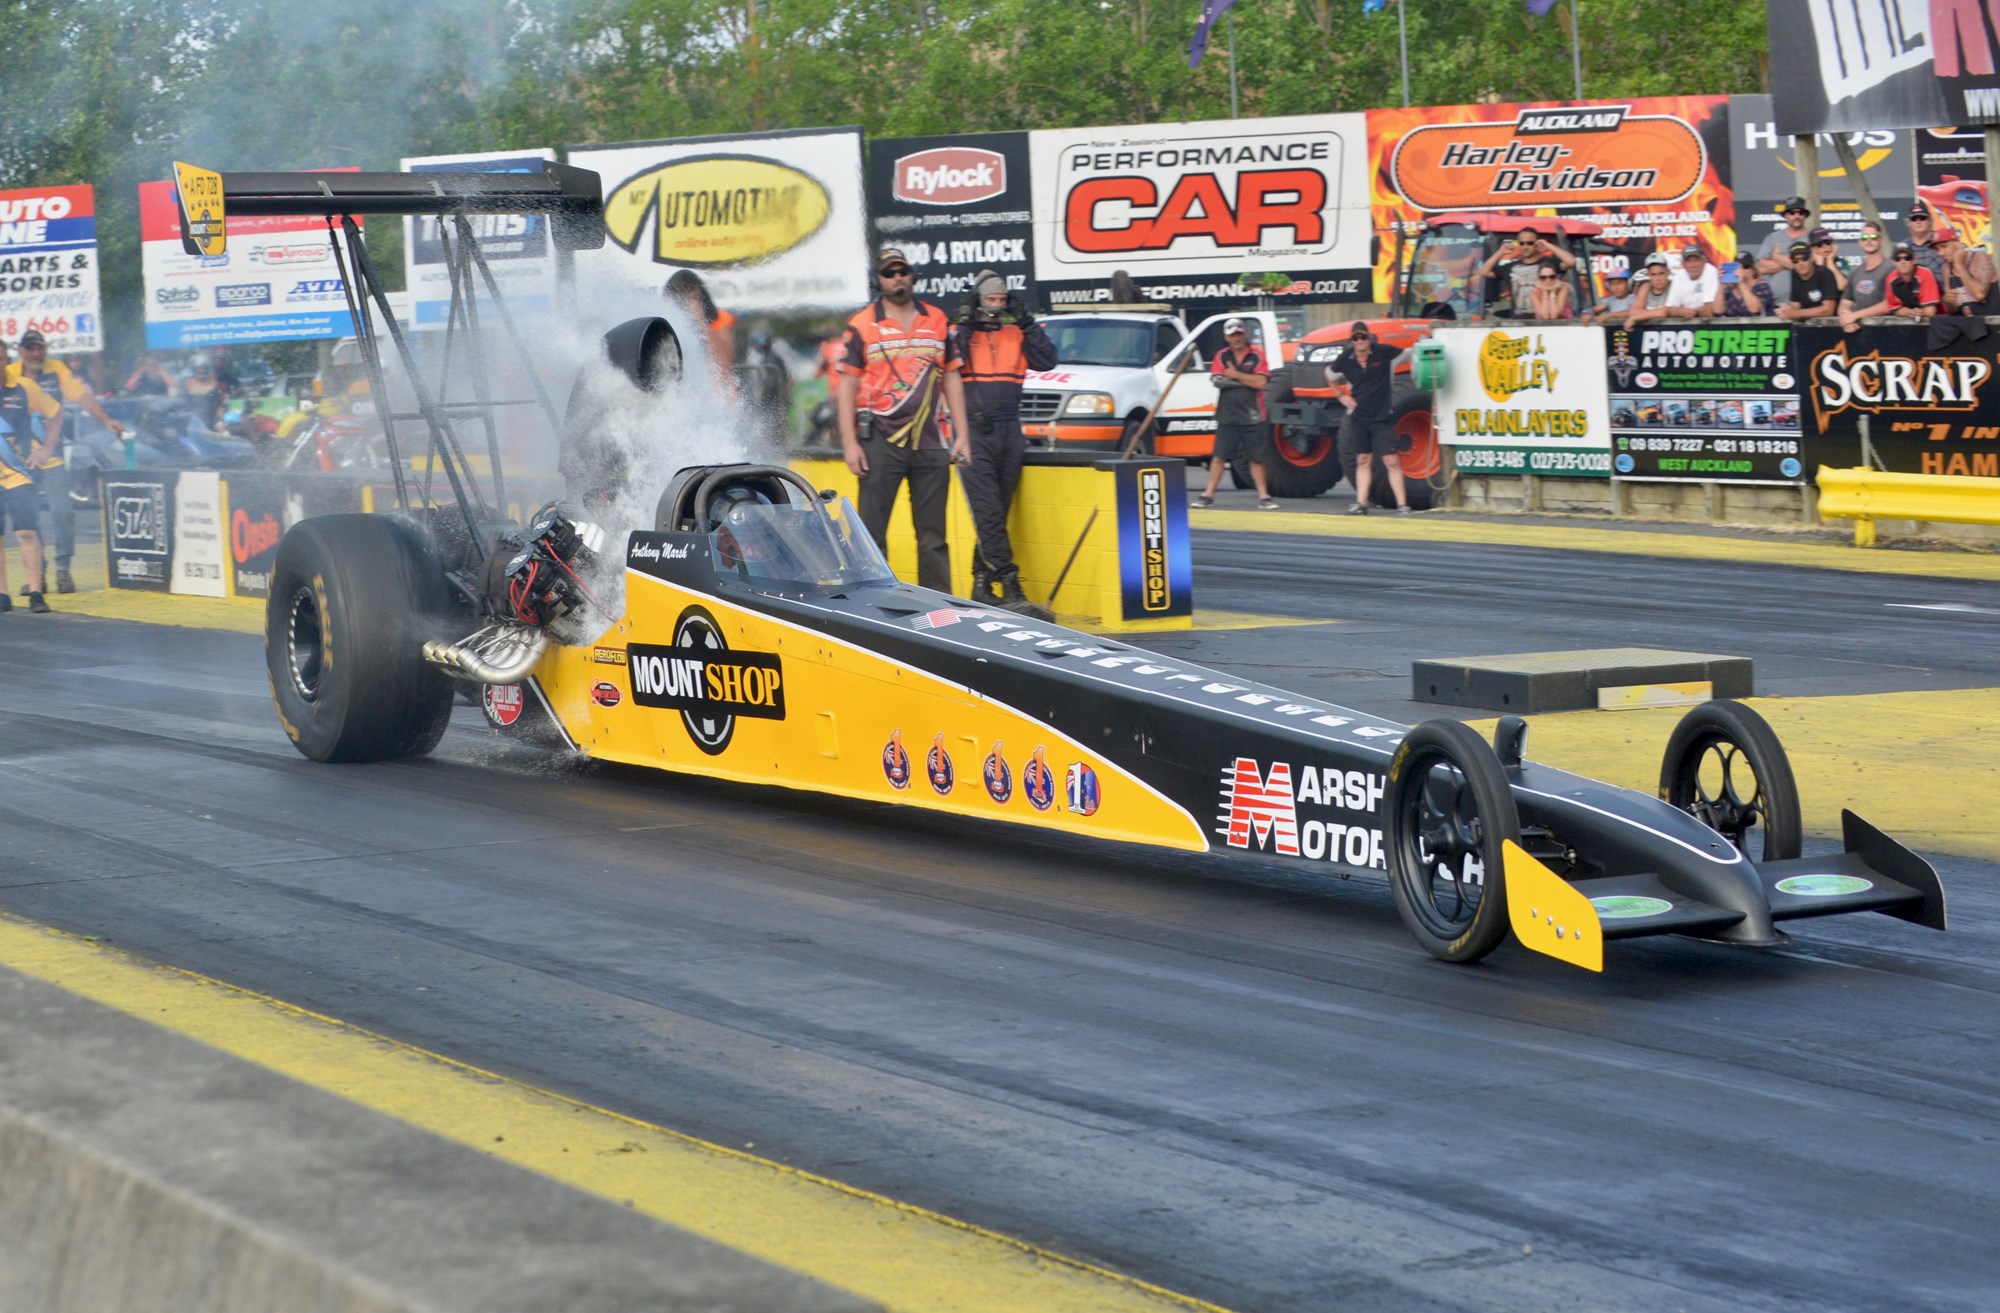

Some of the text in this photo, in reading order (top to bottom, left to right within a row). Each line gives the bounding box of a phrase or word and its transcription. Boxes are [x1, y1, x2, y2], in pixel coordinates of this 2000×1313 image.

[1518, 113, 1621, 132] AUCKLAND
[1121, 138, 1166, 147] Zealand
[1440, 141, 1572, 169] Harley-
[1071, 142, 1330, 171] PERFORMANCE
[906, 163, 994, 195] Rylock
[1489, 166, 1658, 194] Davidson
[1064, 167, 1328, 254] CAR
[72, 254, 89, 270] &
[933, 242, 947, 264] 4
[951, 239, 1027, 263] RYLOCK
[1248, 247, 1310, 258] Magazine
[1641, 330, 1791, 354] PROSTREET
[1641, 355, 1788, 369] AUTOMOTIVE
[1820, 353, 1988, 407] SCRAP
[1455, 409, 1588, 438] DRAINLAYERS
[1630, 438, 1646, 451] 09
[1657, 458, 1753, 473] WEST AUCKLAND
[1143, 474, 1165, 604] MOUNT SHOP
[630, 541, 690, 563] Anthony Marsh
[631, 654, 704, 699] MOUNT
[705, 664, 781, 708] SHOP
